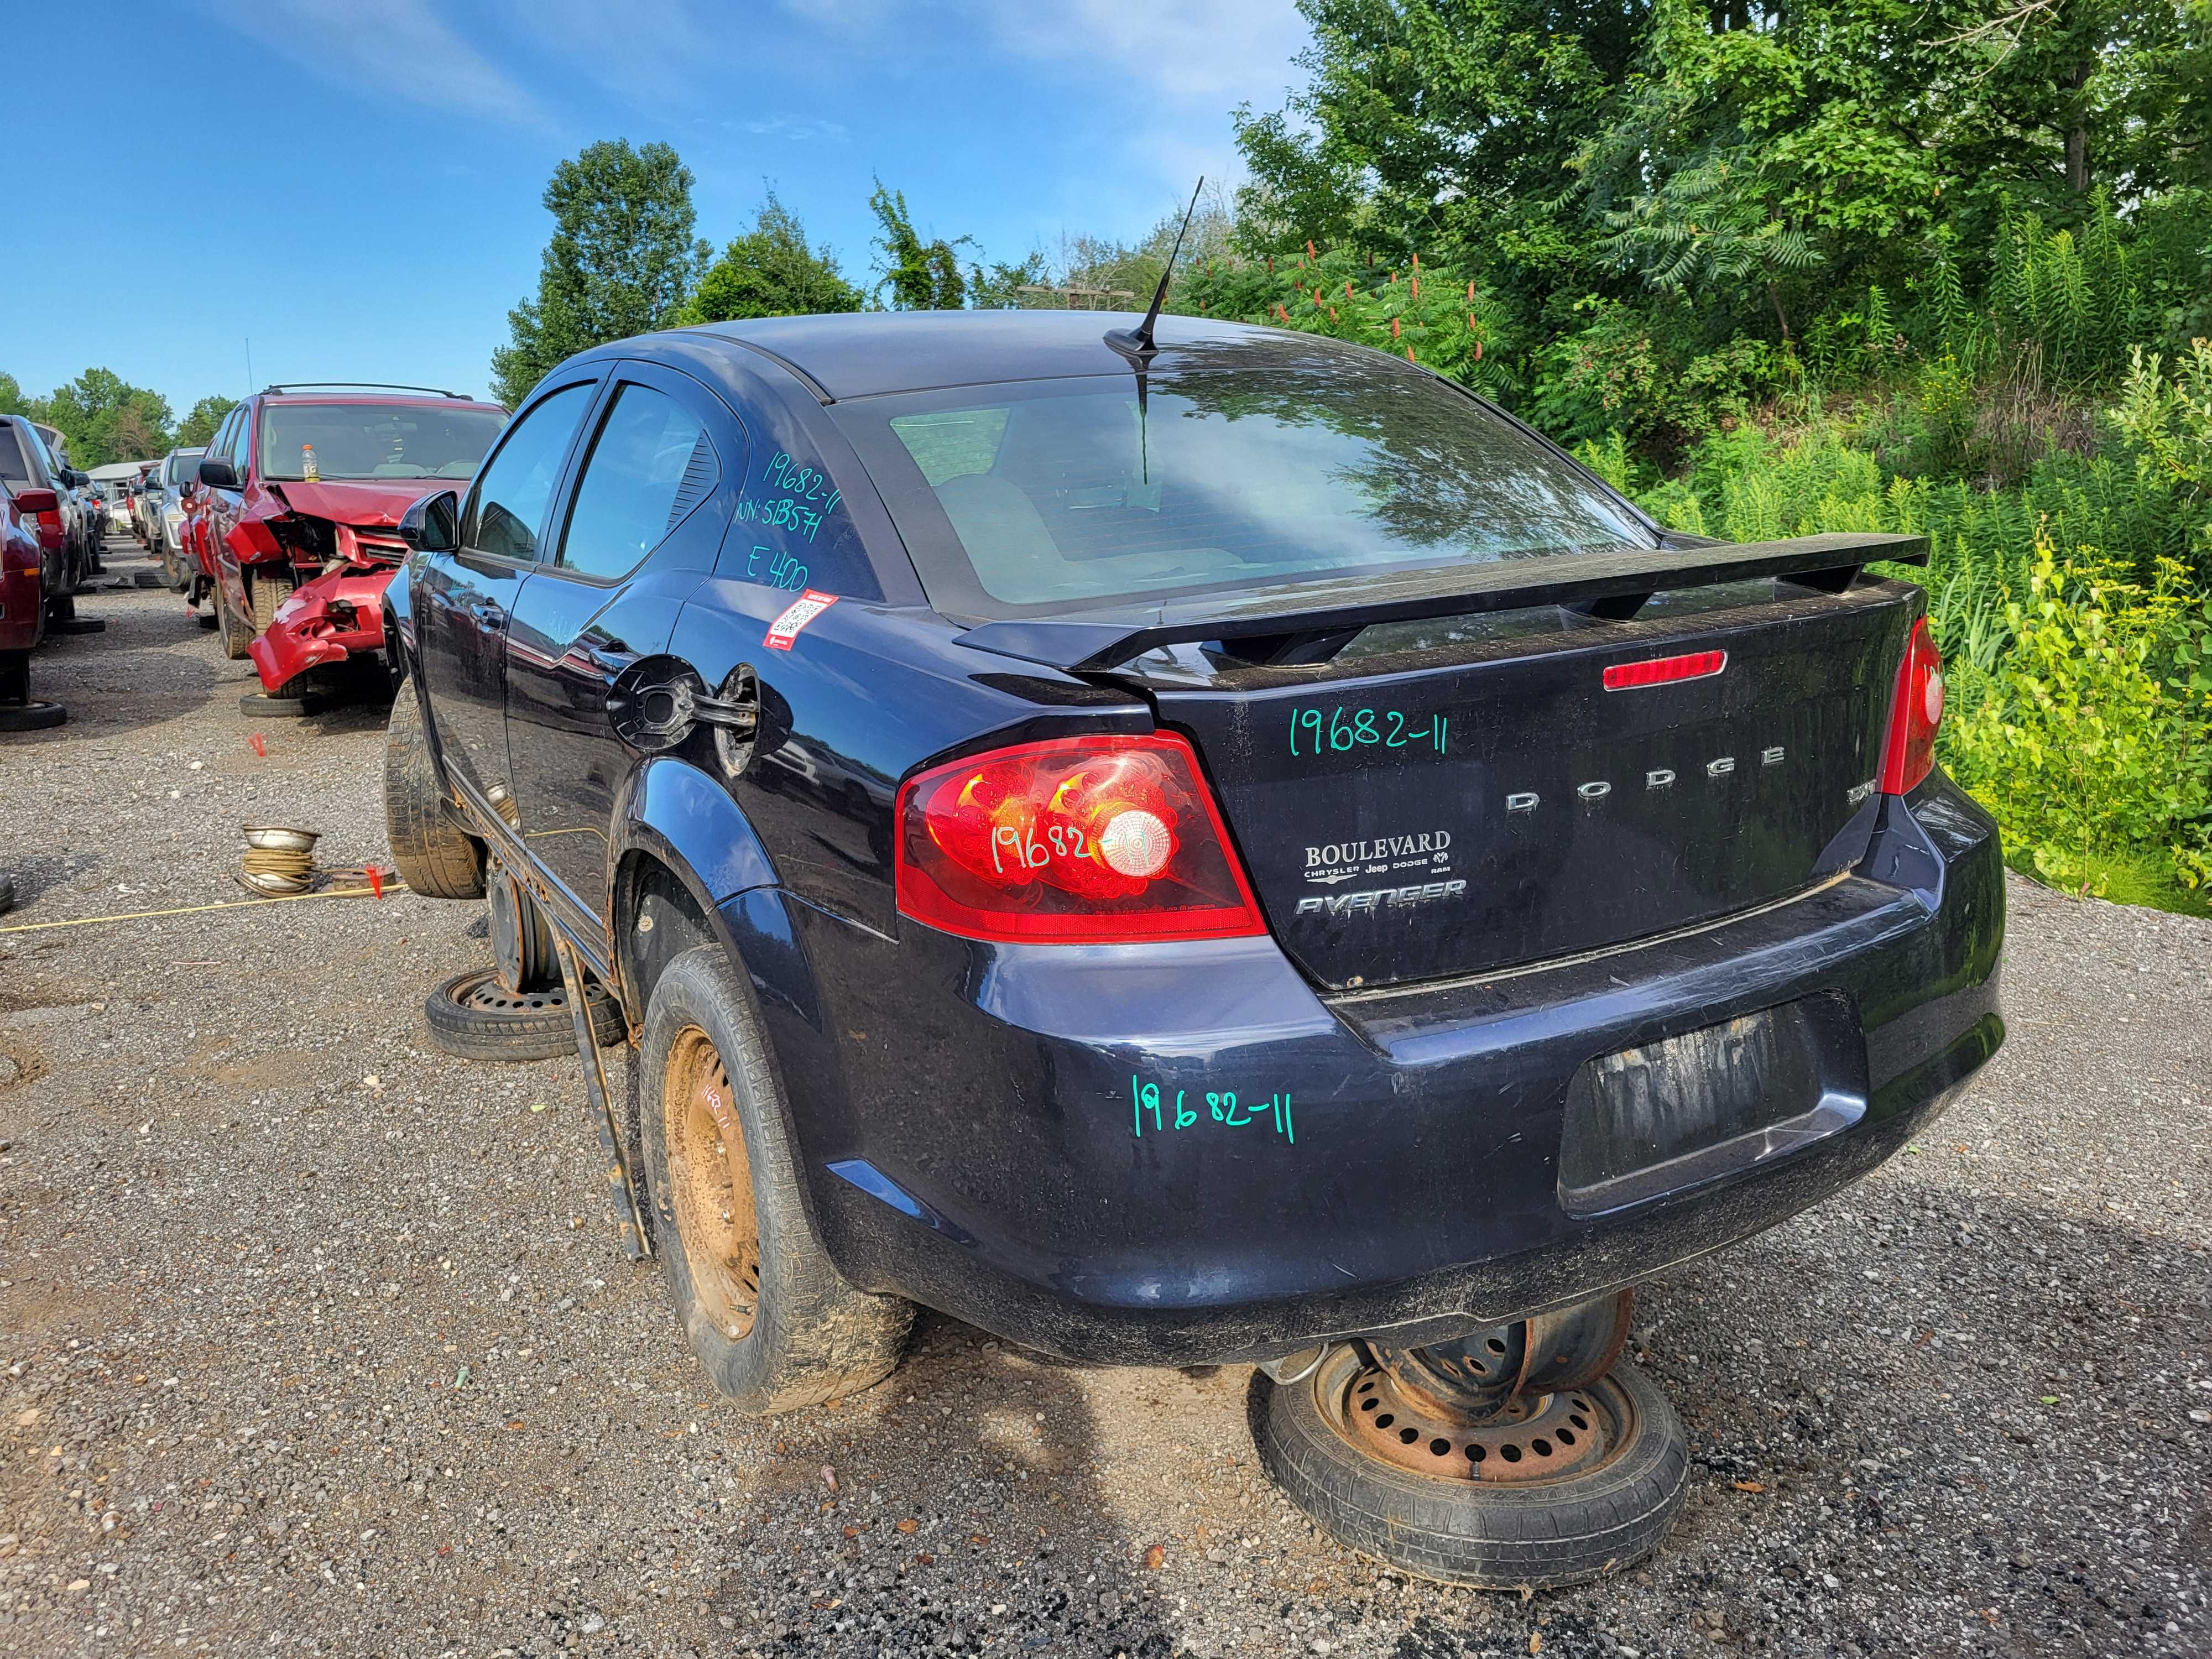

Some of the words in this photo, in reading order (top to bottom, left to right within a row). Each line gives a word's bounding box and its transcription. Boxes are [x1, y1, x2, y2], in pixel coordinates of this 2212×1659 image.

[747, 545, 770, 577] E
[769, 551, 808, 592] 400
[1290, 707, 1447, 756] 19682-11
[1506, 745, 1785, 811] DODGE
[1304, 865, 1360, 878] CHRYSLER
[1365, 864, 1389, 874] Jeep
[1392, 858, 1428, 869] DODGE
[1431, 866, 1451, 874] RAM
[1305, 830, 1451, 868] BOULEVARD
[1295, 879, 1467, 915] AVENGER
[1133, 1074, 1294, 1145] 19682-11
